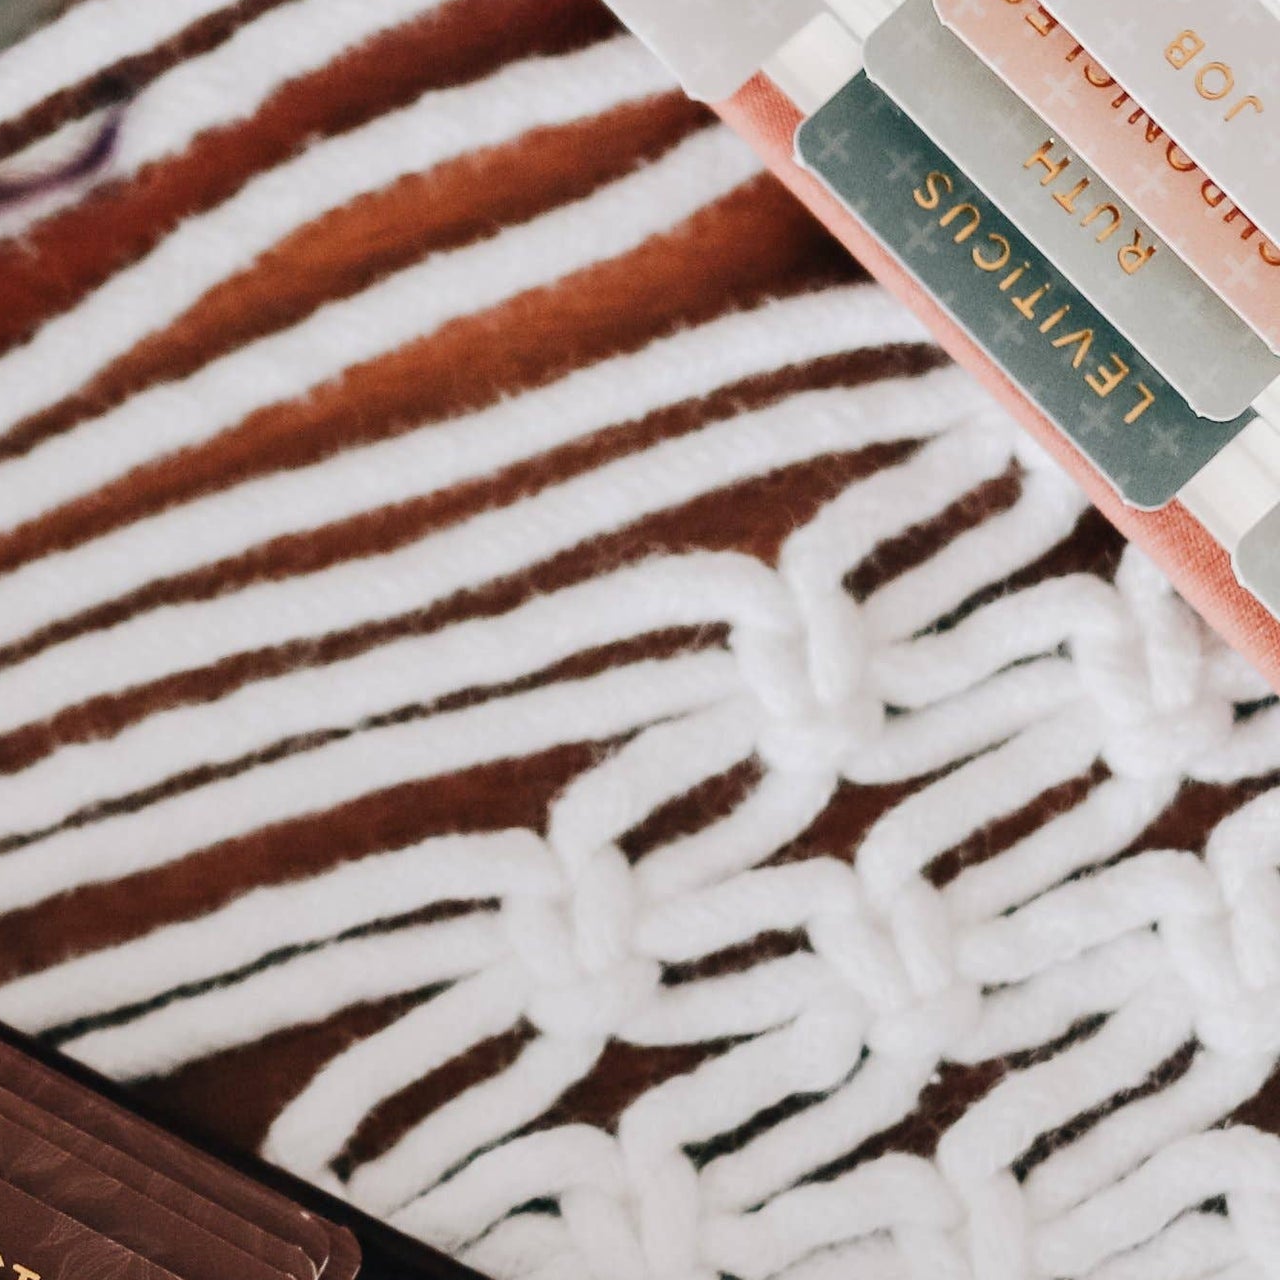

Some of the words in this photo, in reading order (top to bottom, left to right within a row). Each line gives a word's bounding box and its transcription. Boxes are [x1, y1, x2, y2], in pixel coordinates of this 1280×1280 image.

[1161, 28, 1263, 124] JOB
[1020, 134, 1156, 275] RUTH
[910, 165, 1155, 423] LEVITICUS
